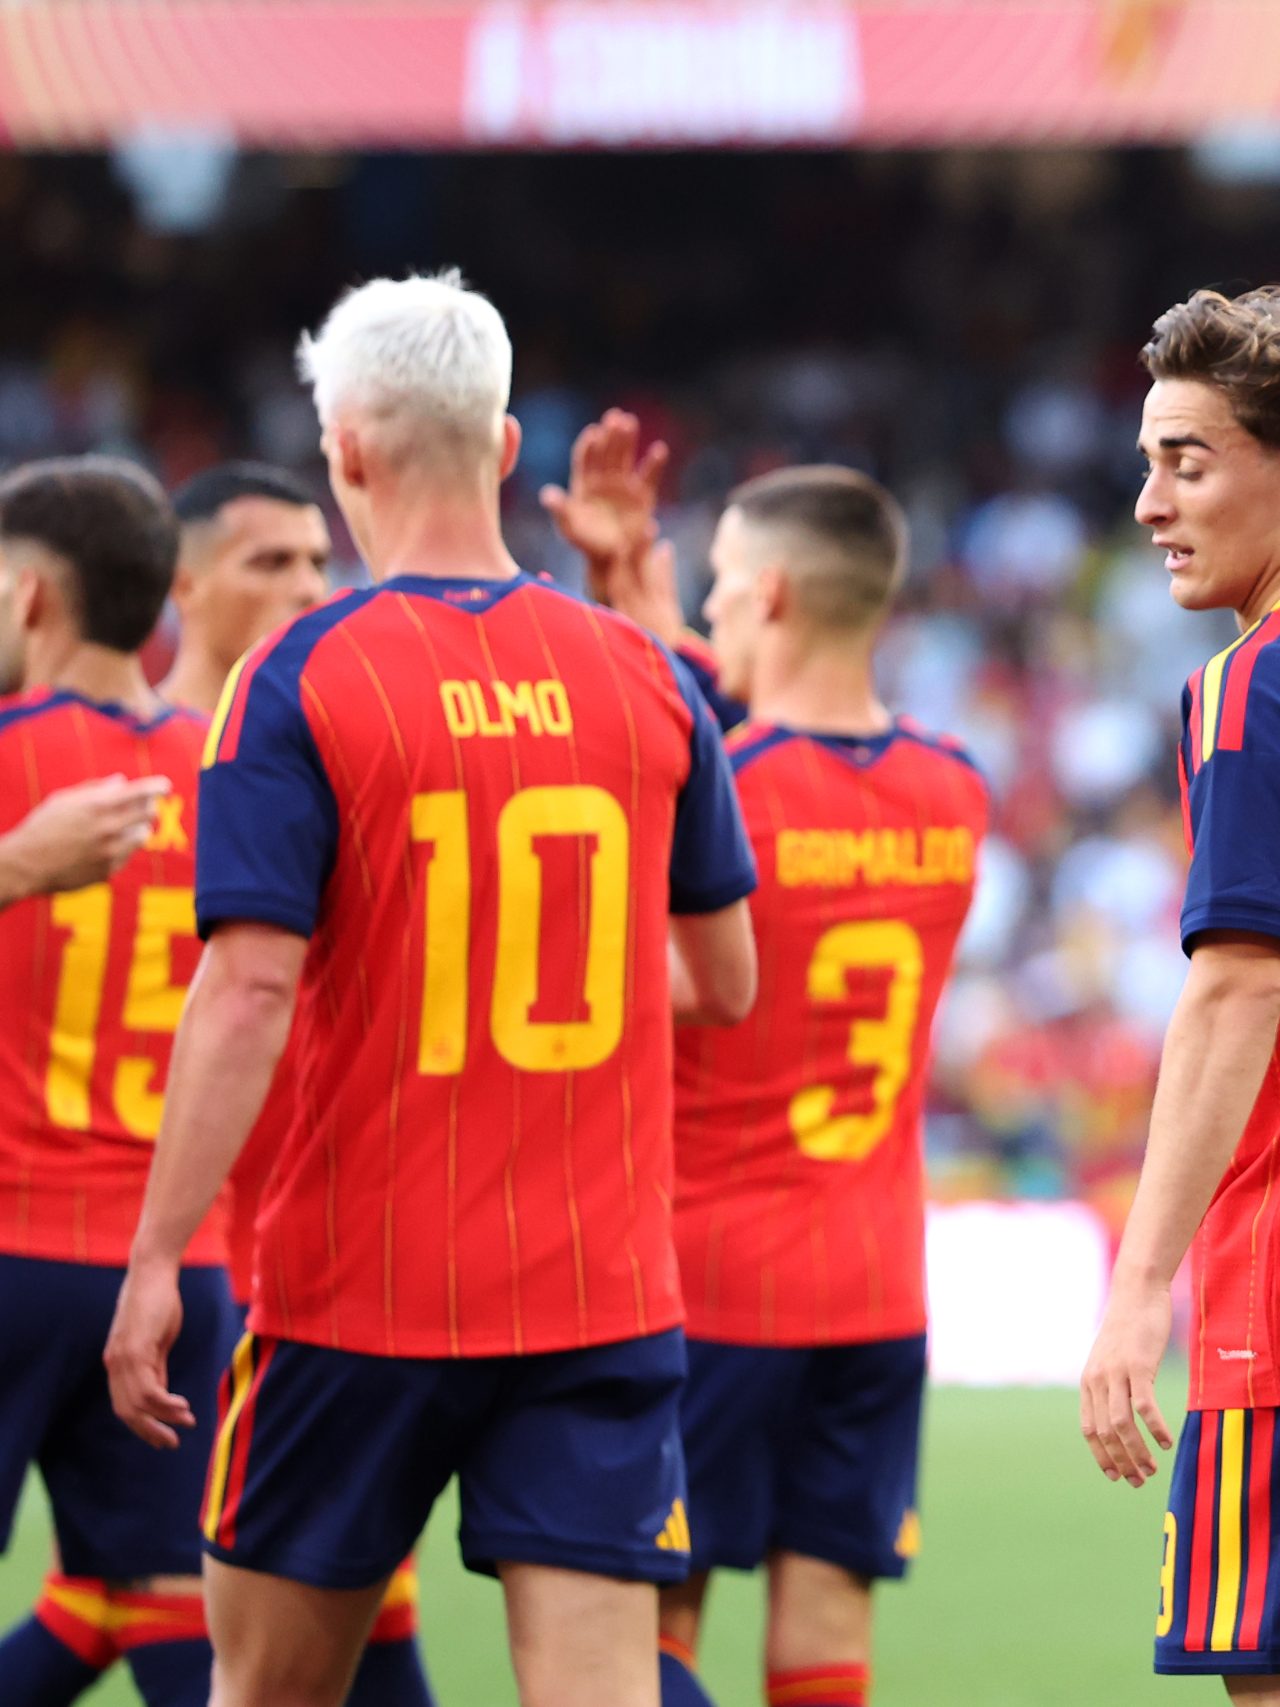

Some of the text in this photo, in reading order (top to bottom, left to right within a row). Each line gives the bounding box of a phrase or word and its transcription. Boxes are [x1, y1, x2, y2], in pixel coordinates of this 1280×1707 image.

[440, 680, 573, 737] OLMO
[45, 884, 196, 1139] 15
[411, 785, 629, 1075] 10
[789, 919, 924, 1160] 3
